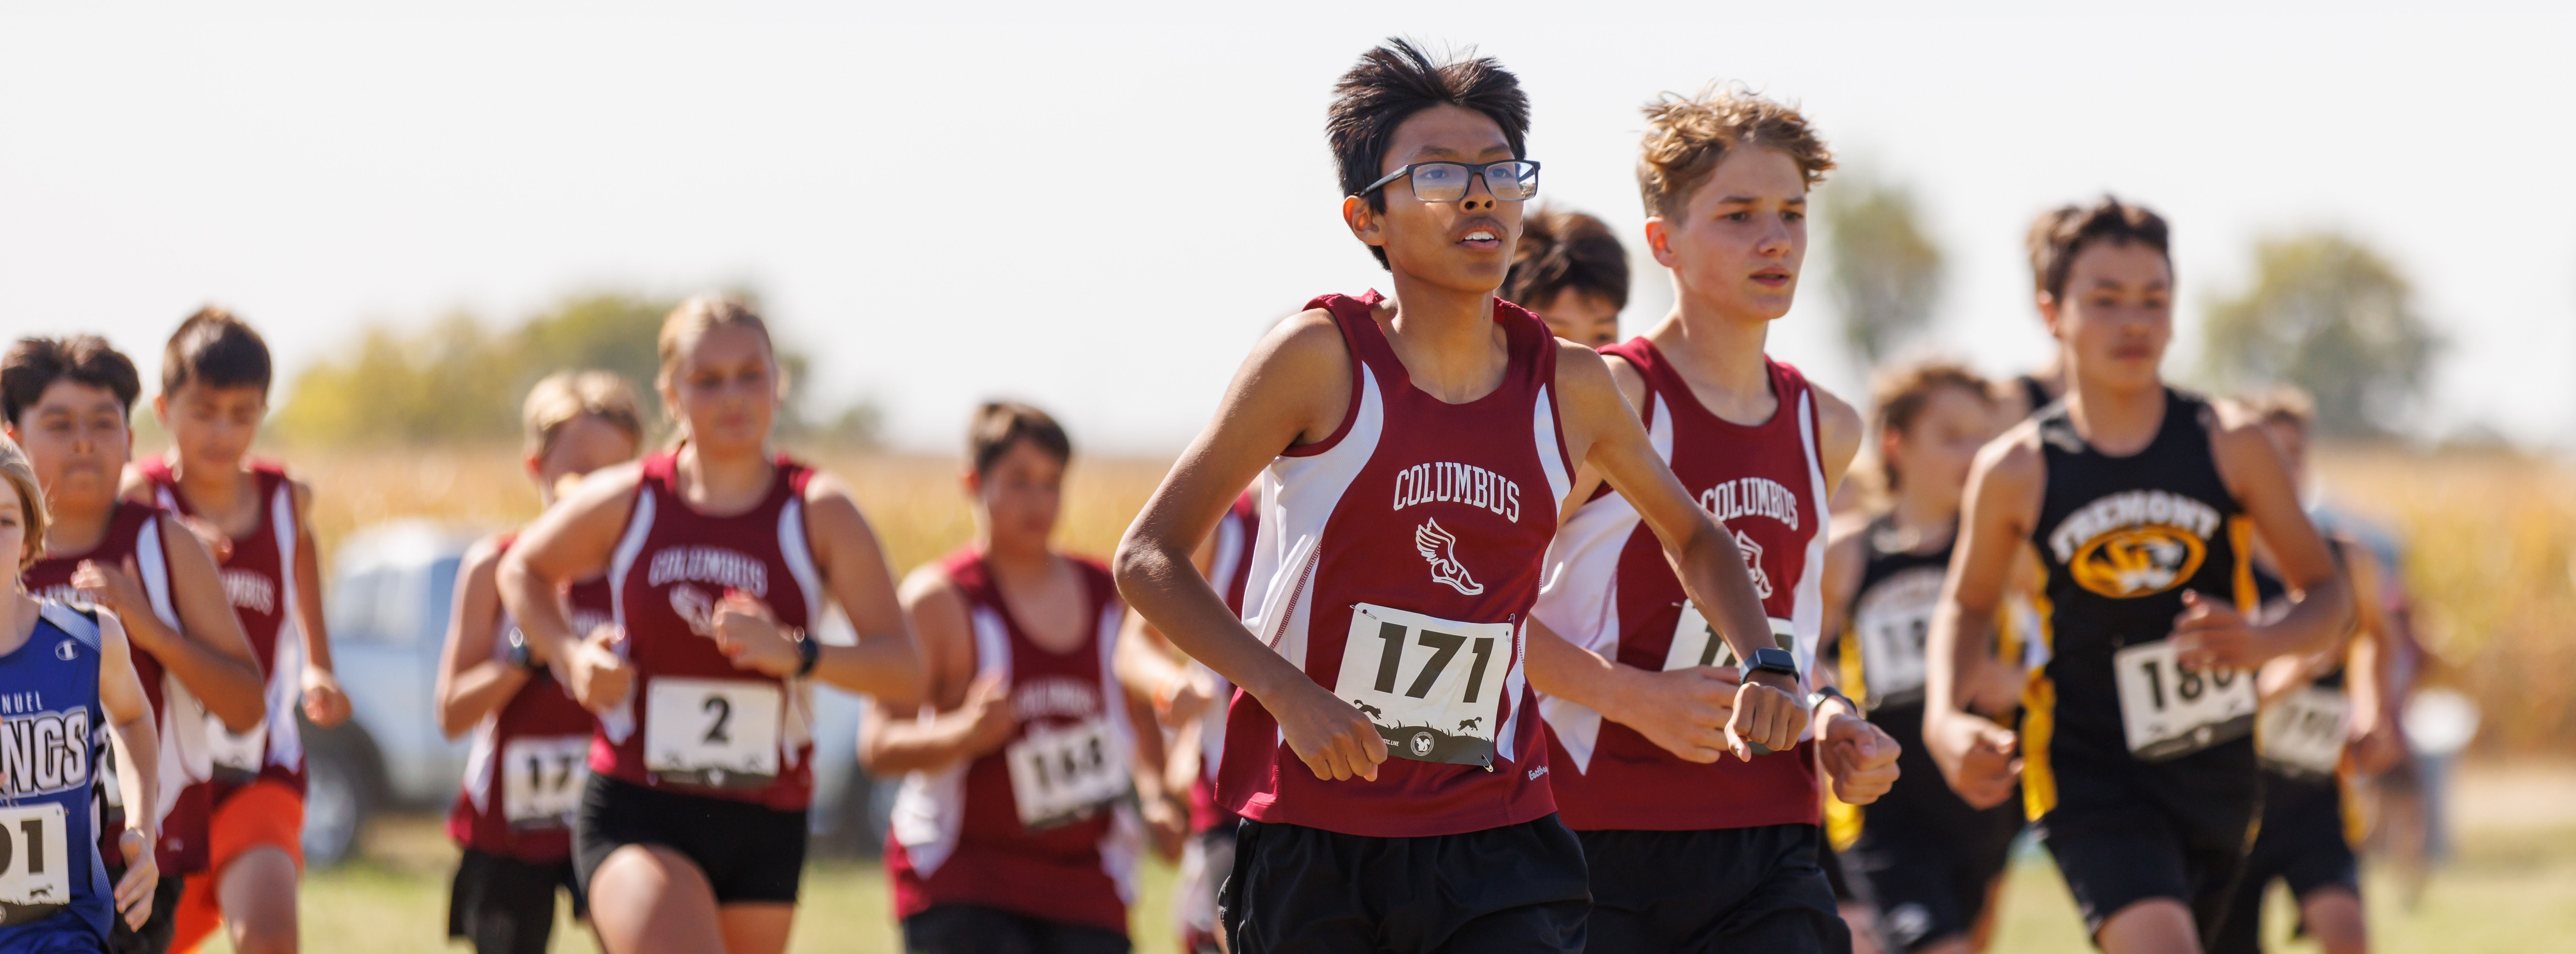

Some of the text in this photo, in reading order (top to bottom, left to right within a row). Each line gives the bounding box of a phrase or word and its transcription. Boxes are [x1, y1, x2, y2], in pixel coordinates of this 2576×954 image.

[1393, 462, 1519, 523] COLUMBUS
[1700, 477, 1799, 531] COLUMBUS
[2048, 489, 2222, 564] FREMONT
[1374, 622, 1494, 703] 171
[1, 690, 43, 714] NUEL
[703, 695, 731, 745] 2
